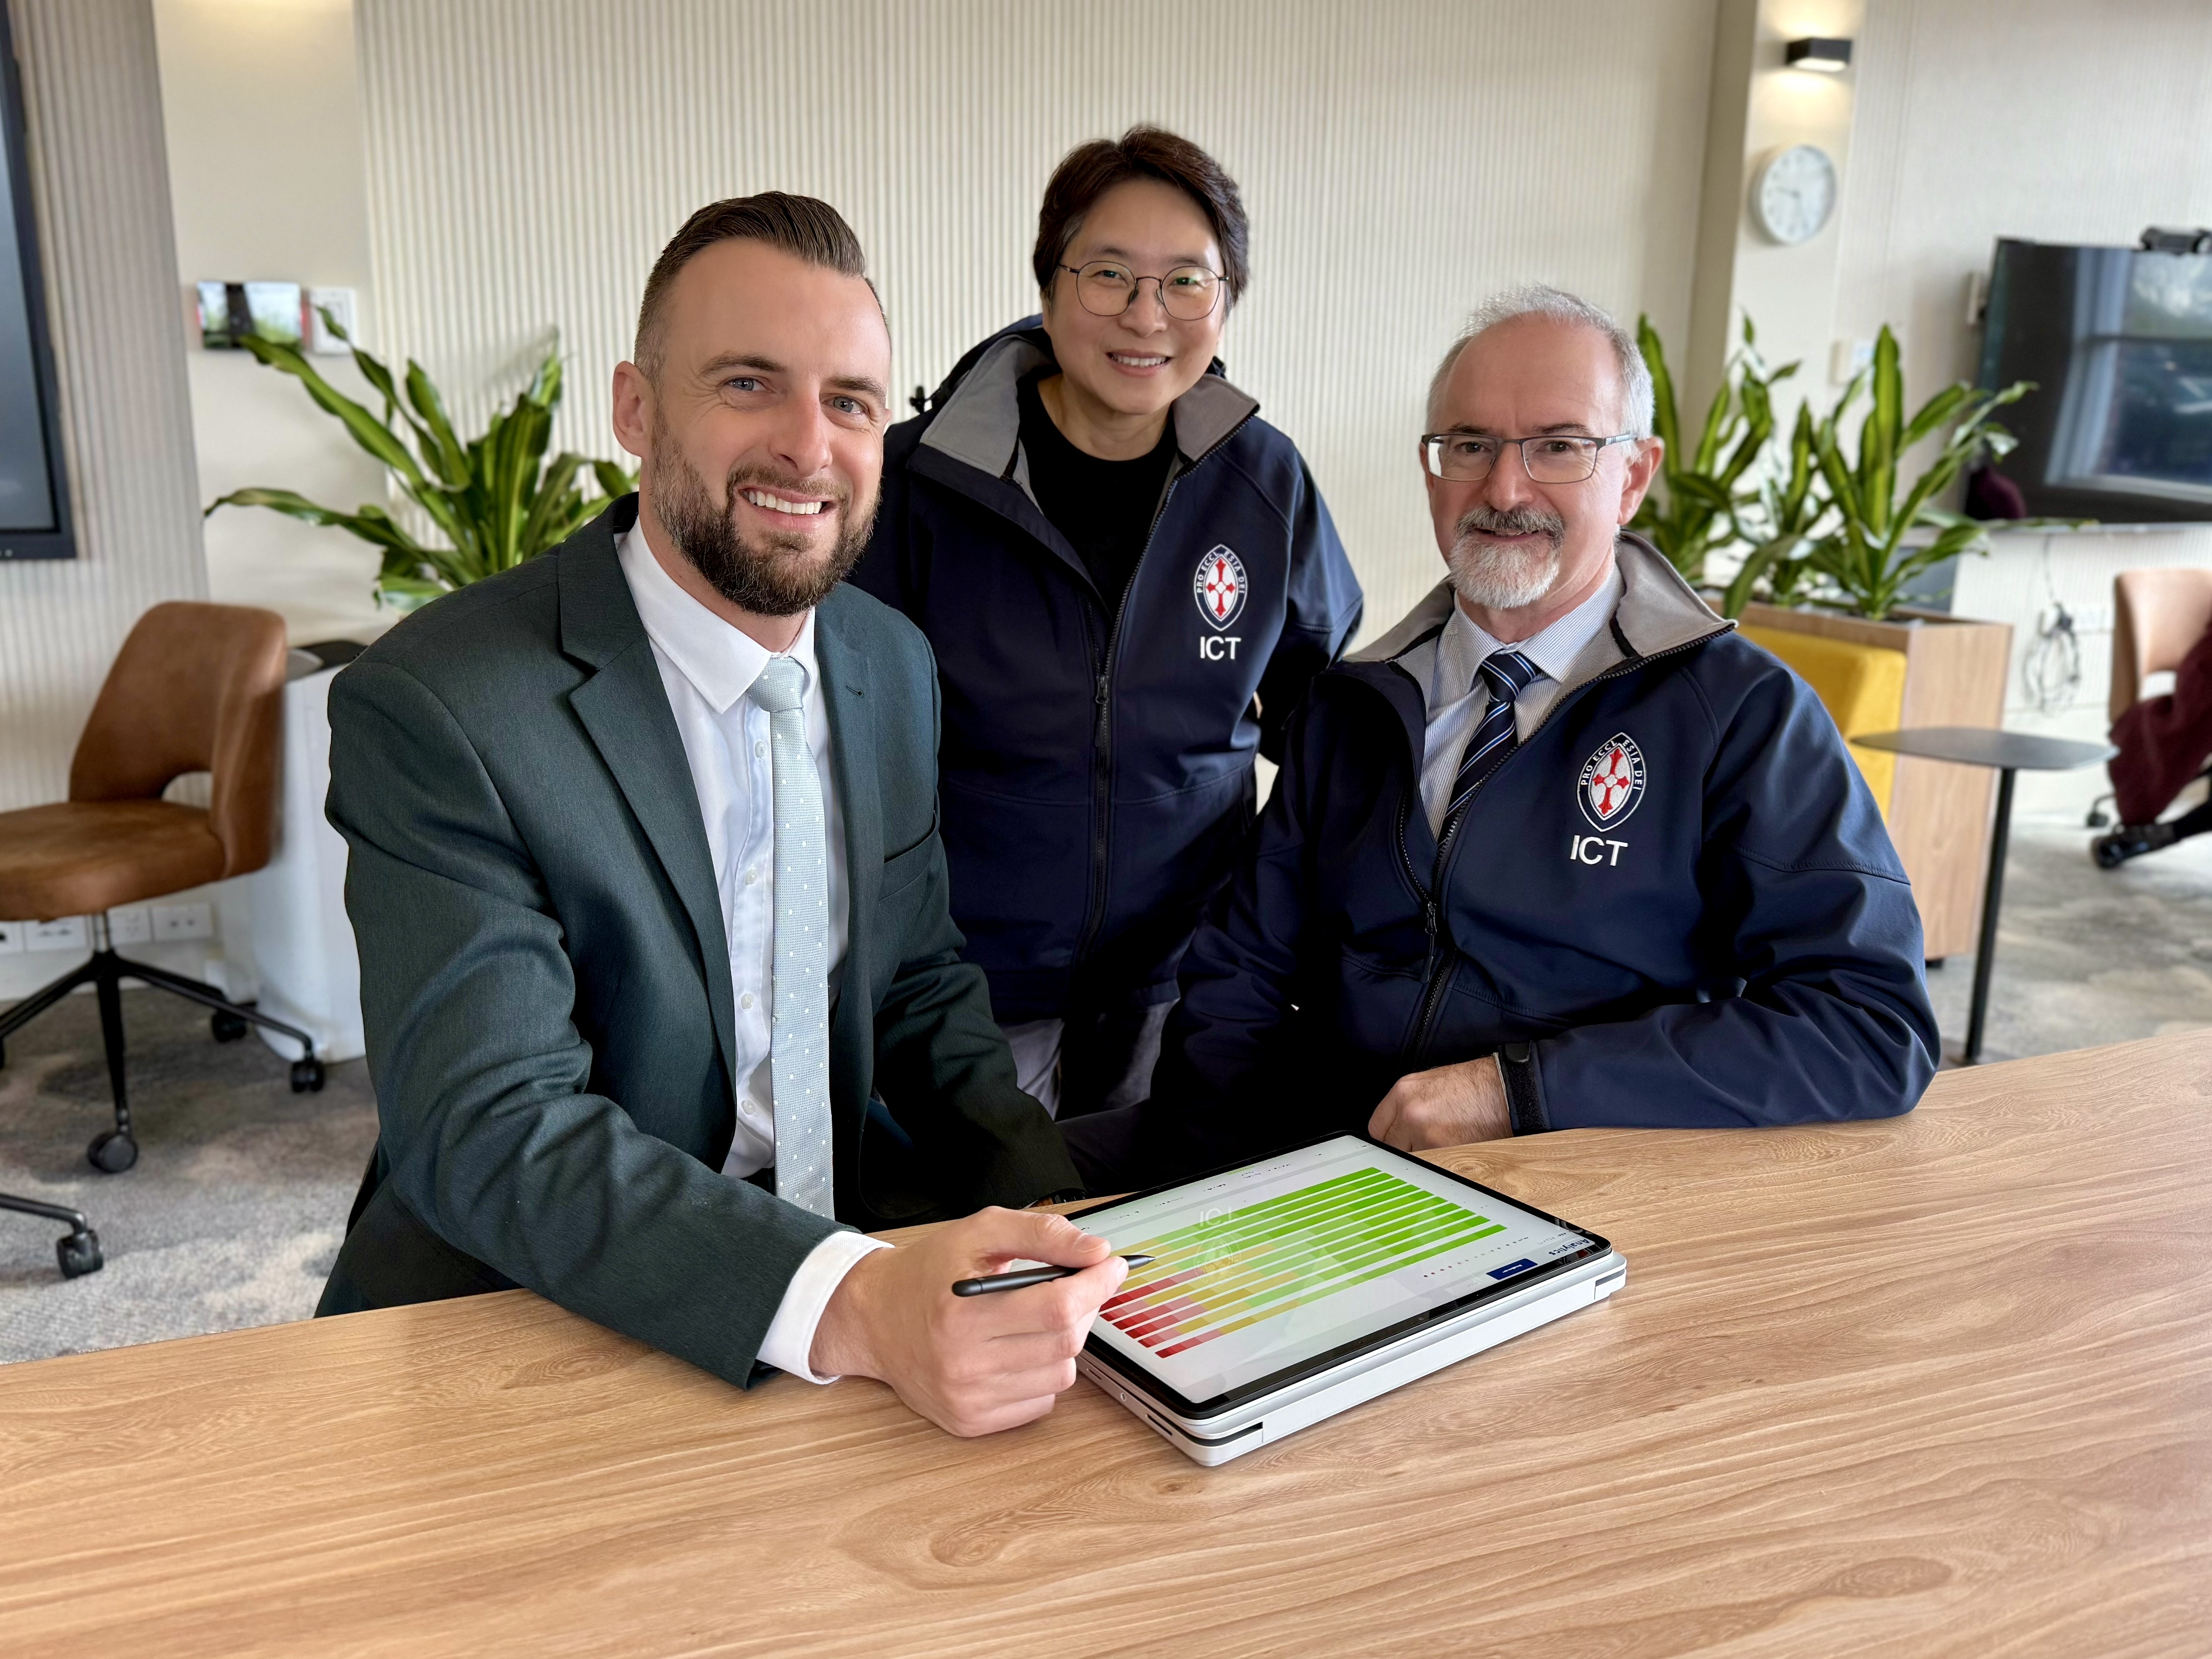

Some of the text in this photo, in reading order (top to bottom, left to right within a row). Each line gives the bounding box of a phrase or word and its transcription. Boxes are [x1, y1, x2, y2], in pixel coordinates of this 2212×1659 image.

[1200, 636, 1241, 660] ICT
[1581, 765, 1593, 785] PRO
[1633, 770, 1643, 790] DEI
[1570, 835, 1628, 867] ICT
[1548, 1239, 1590, 1255] Analytics
